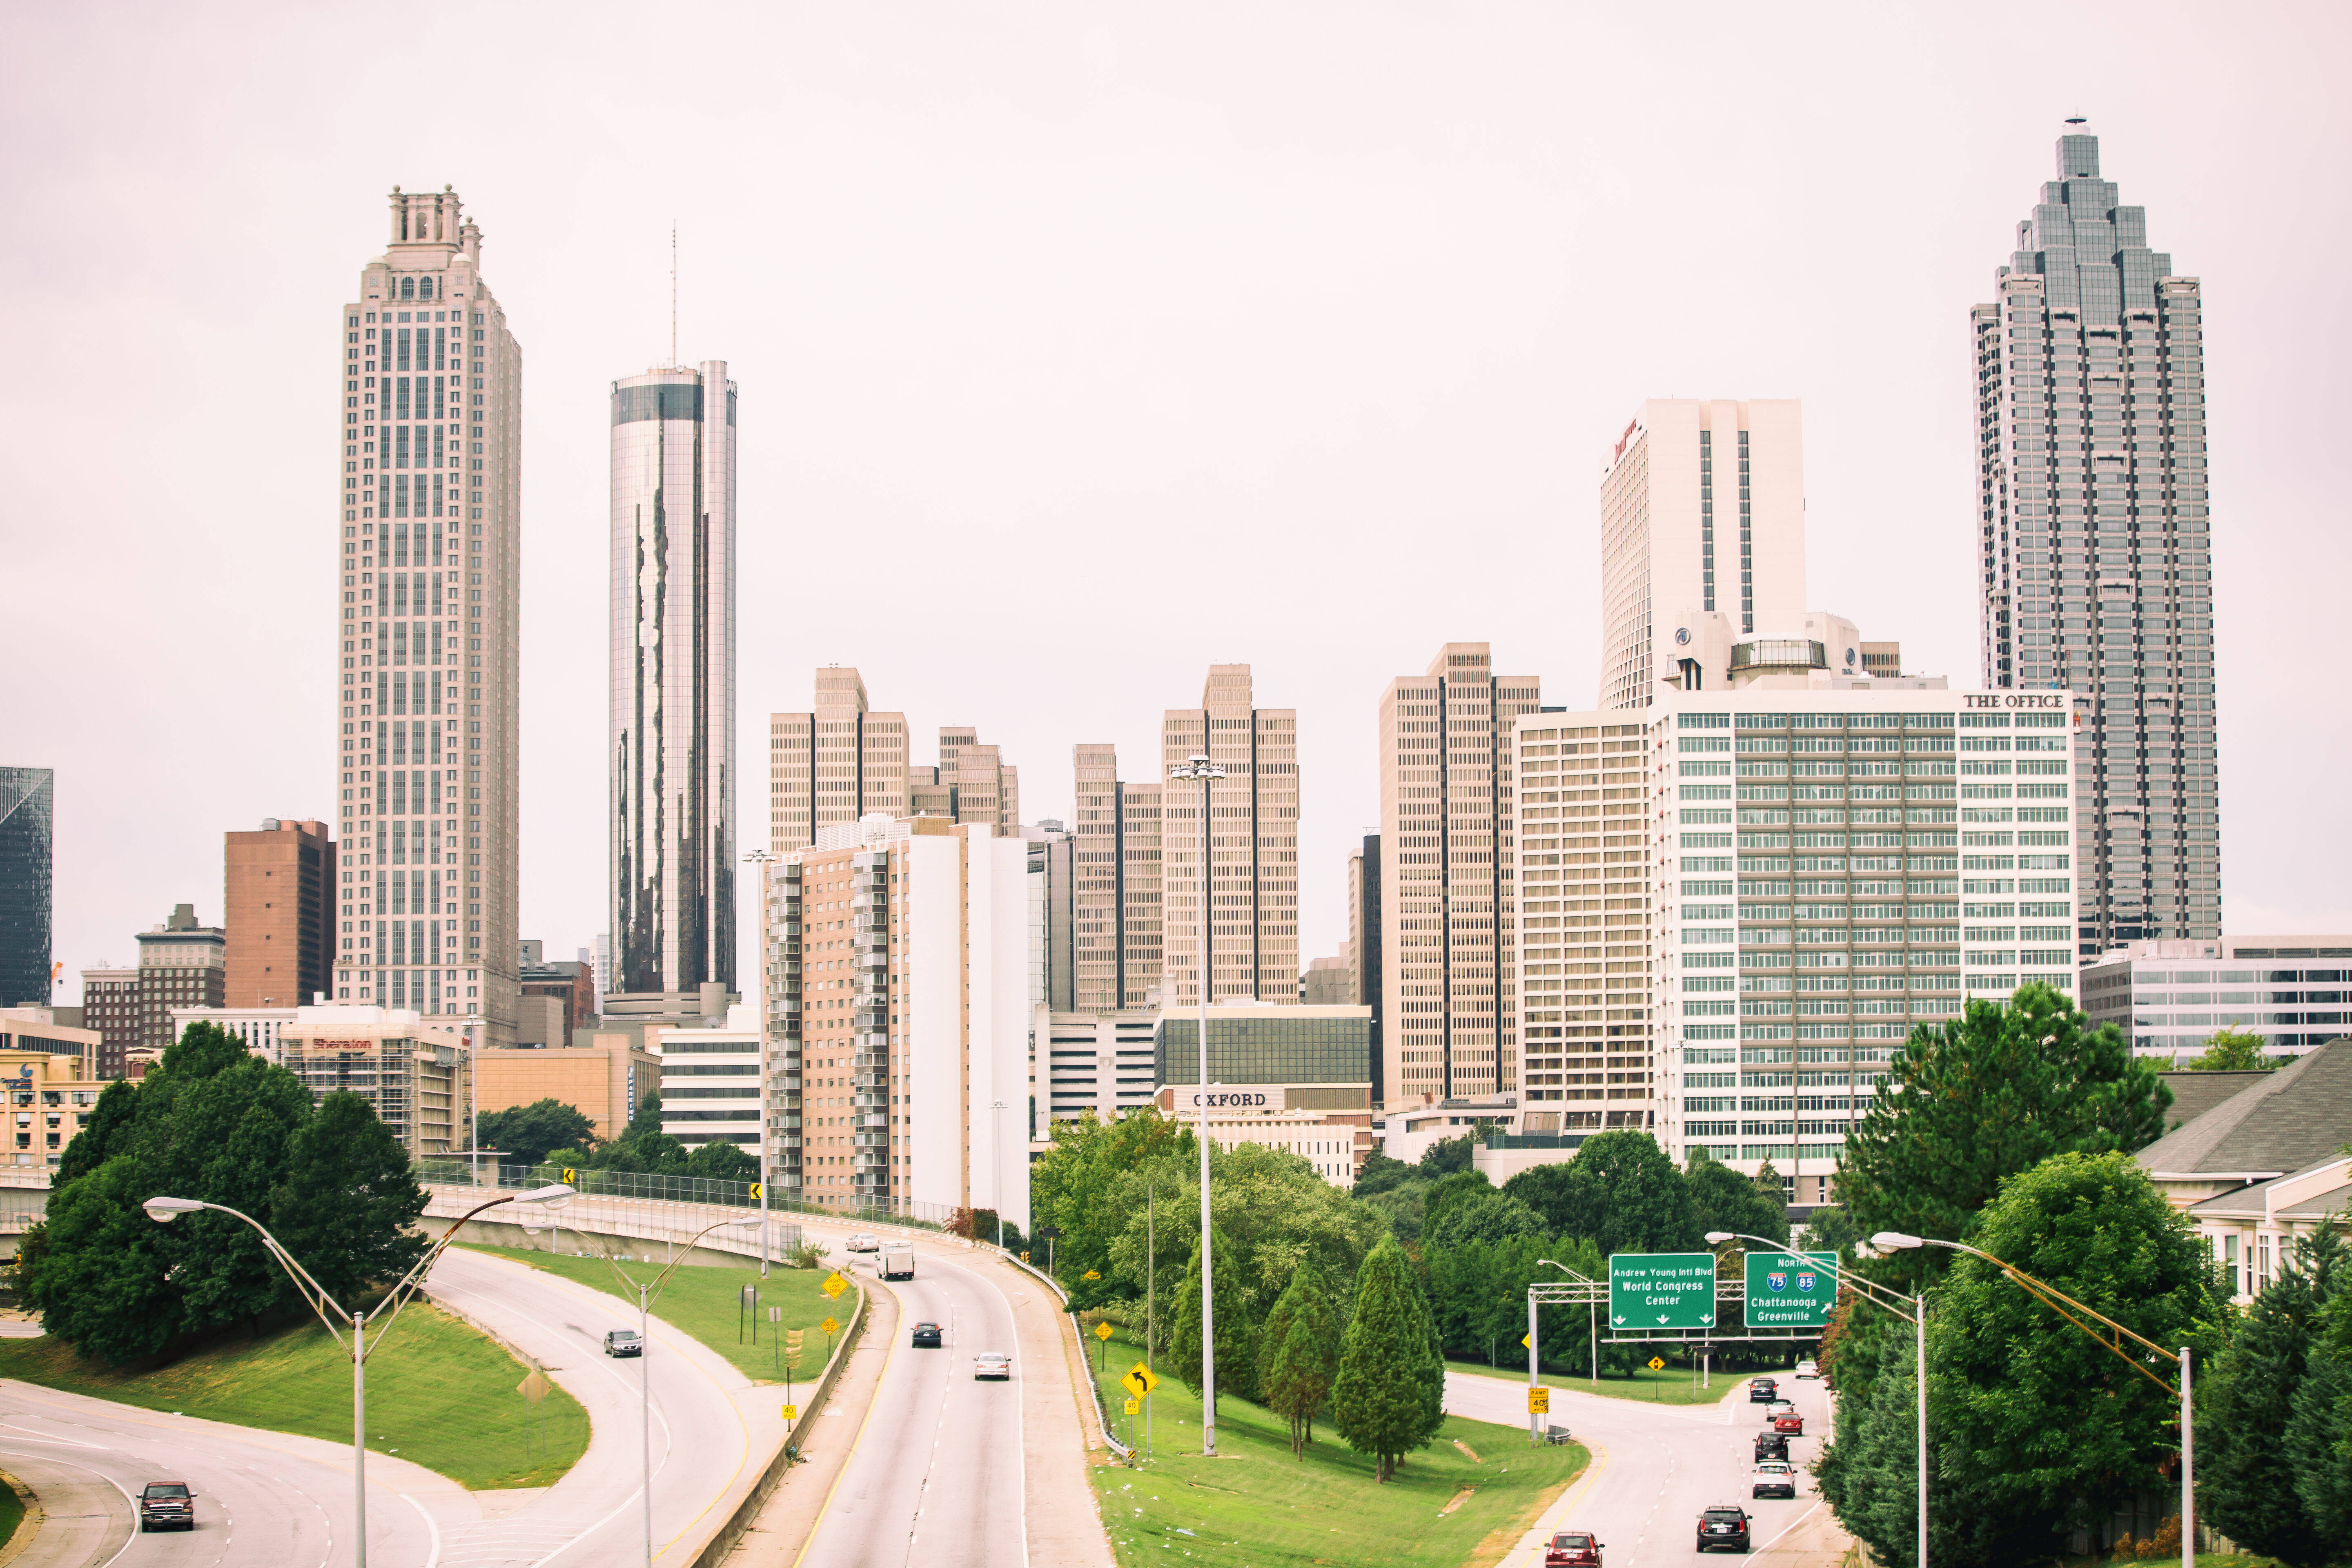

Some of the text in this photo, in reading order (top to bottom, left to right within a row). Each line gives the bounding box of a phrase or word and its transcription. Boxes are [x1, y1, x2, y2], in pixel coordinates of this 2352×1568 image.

[1963, 695, 2063, 708] THE OFFICE
[314, 1038, 372, 1049] Sheraton
[1194, 1094, 1265, 1106] OXFORD
[1613, 1267, 1712, 1278] Andrew Young Intl Blvd
[1623, 1281, 1703, 1293] World Congress
[1770, 1278, 1784, 1287] 75
[1800, 1278, 1813, 1287] 85
[1646, 1296, 1680, 1305] Center
[1751, 1298, 1816, 1307] Chattanooga
[1758, 1312, 1809, 1321] Greenville
